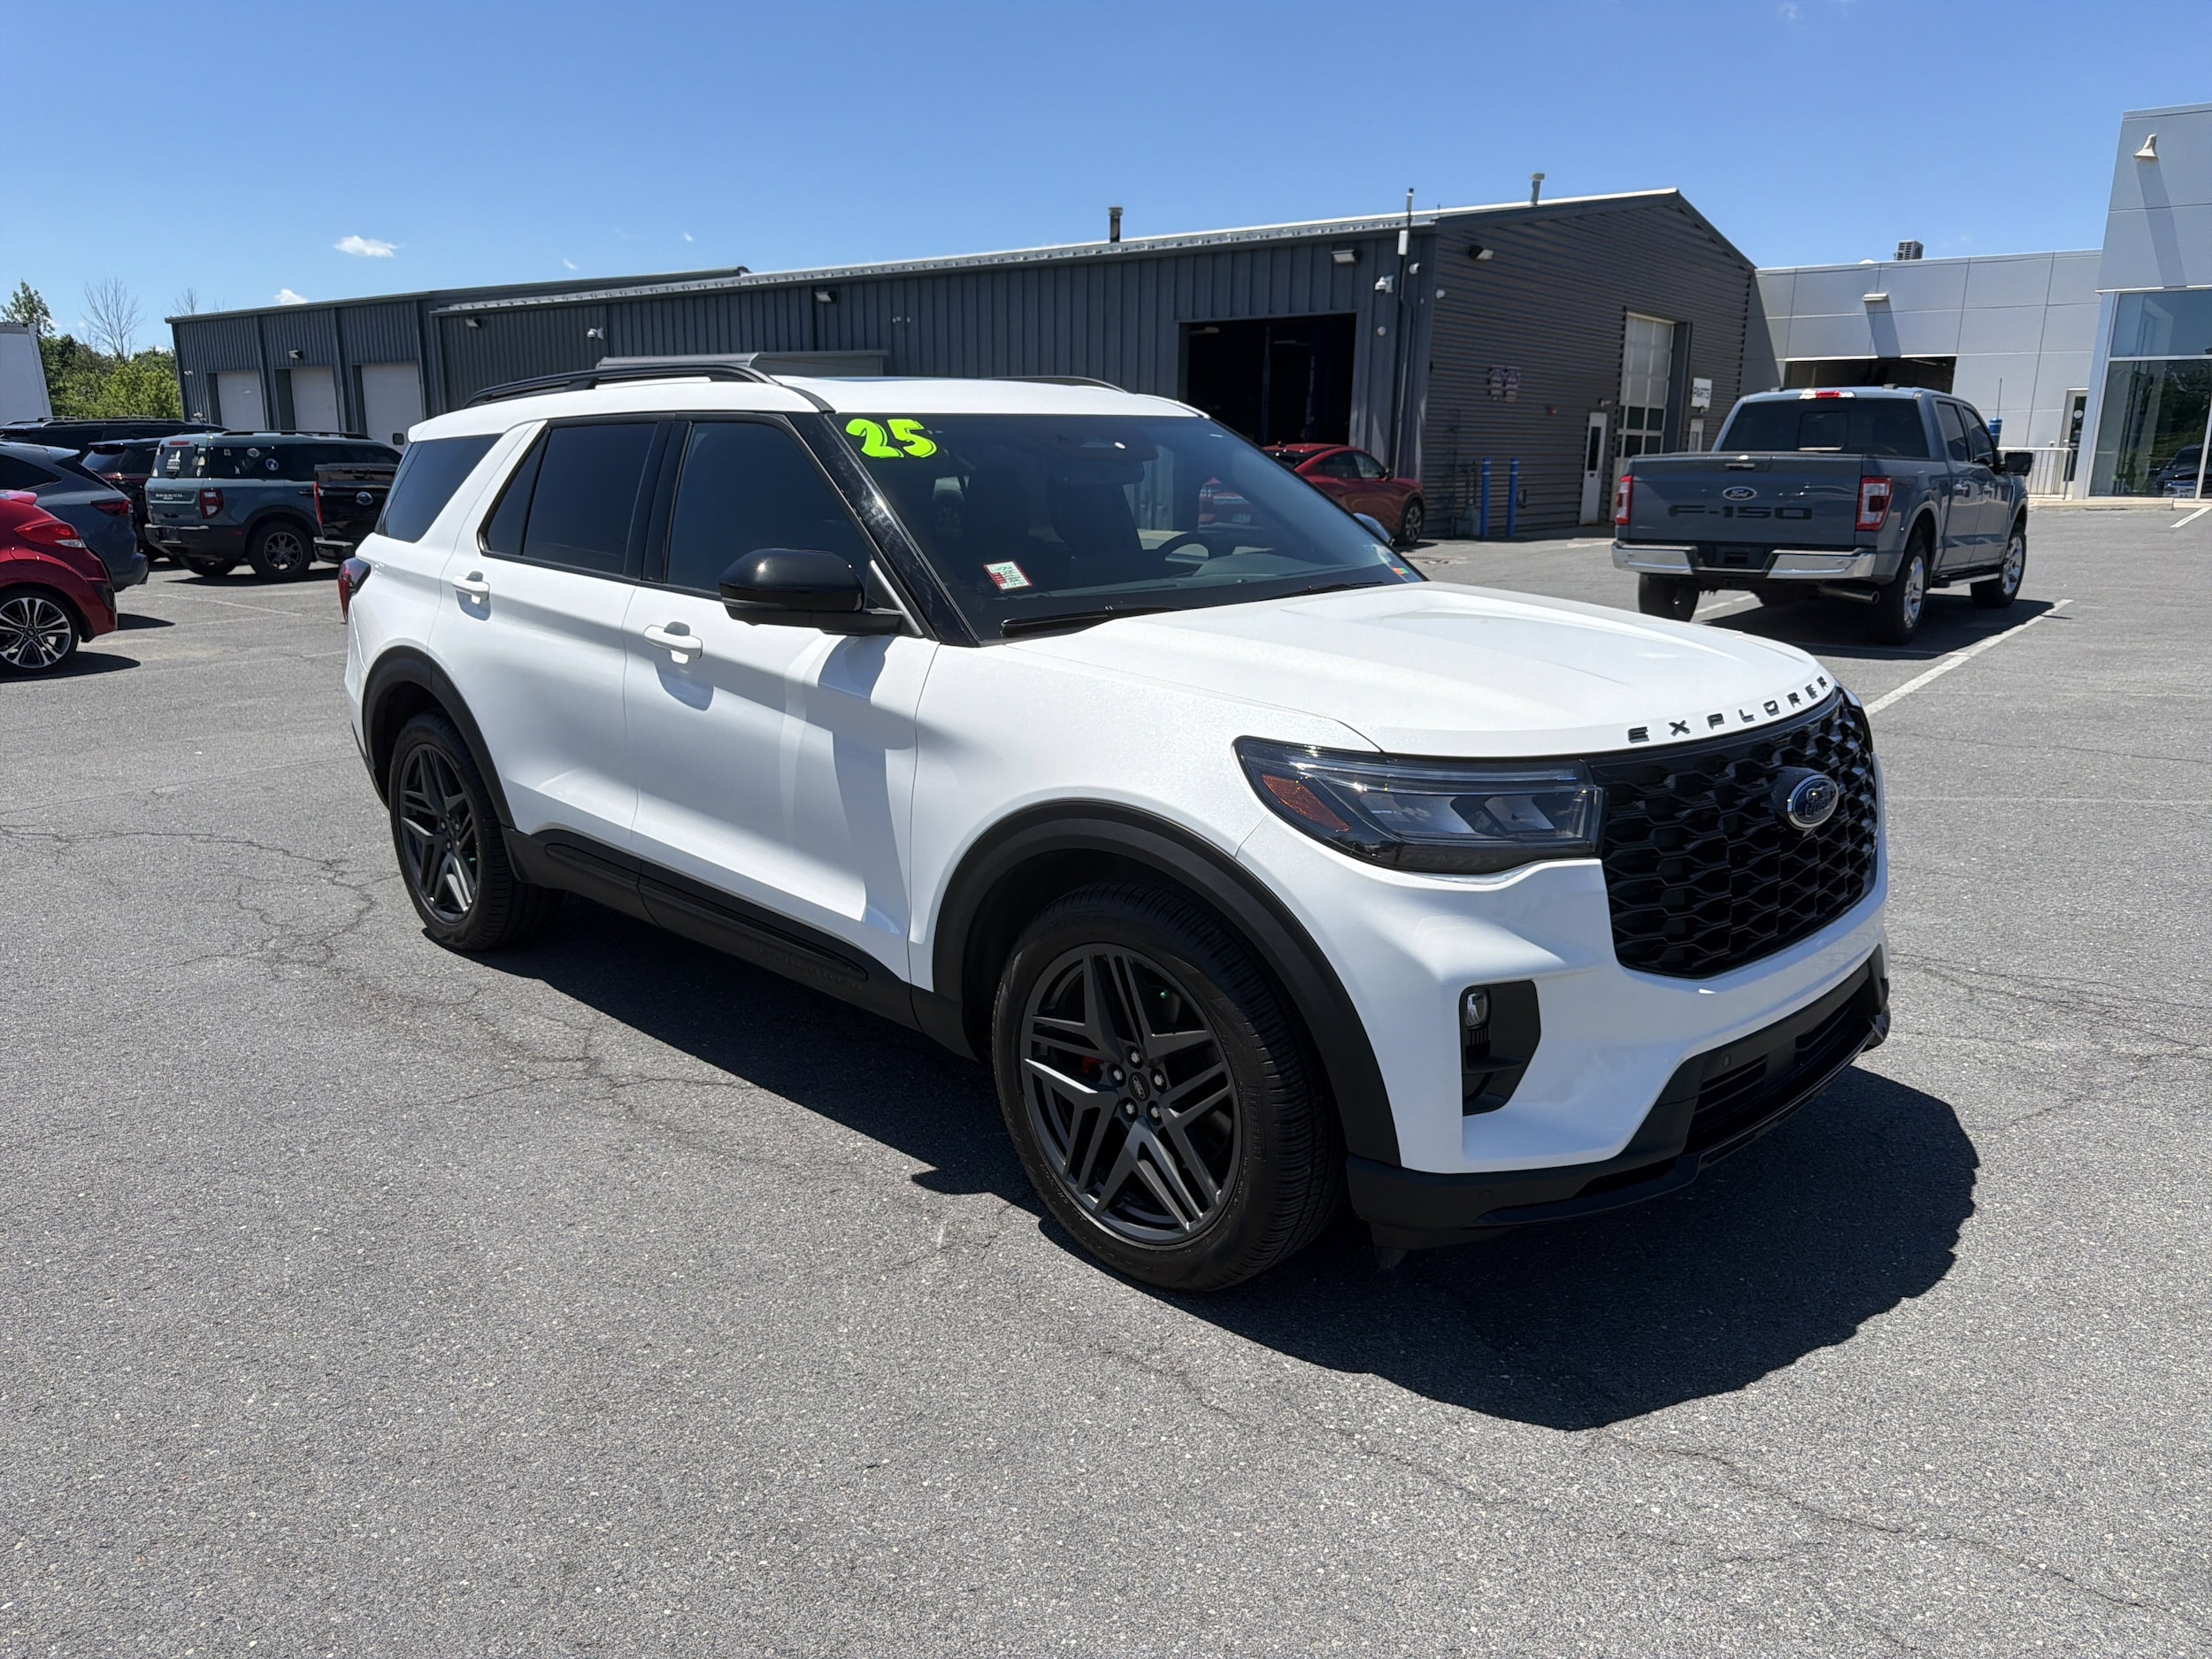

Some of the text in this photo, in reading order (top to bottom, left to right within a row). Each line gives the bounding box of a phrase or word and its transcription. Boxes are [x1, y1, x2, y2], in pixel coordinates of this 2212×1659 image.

[845, 418, 938, 458] 25
[1669, 504, 1813, 520] F-150
[1627, 675, 1829, 744] EXPLORER
